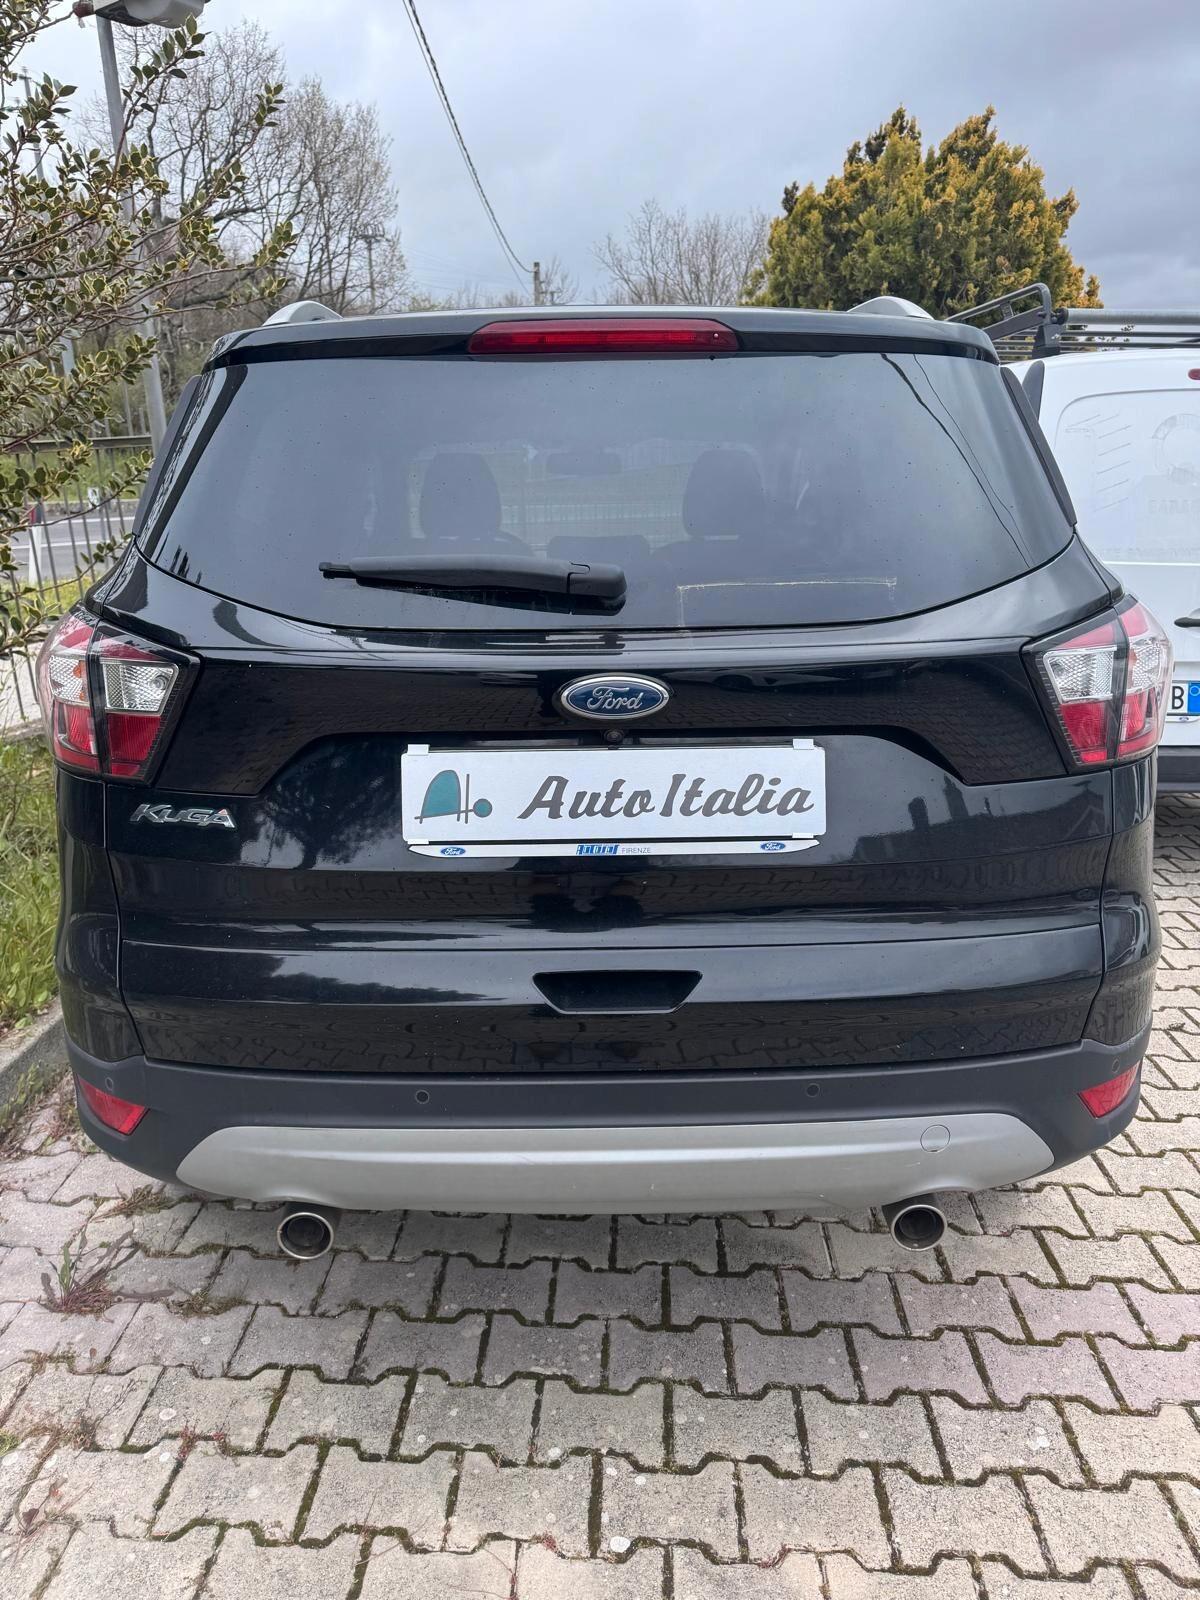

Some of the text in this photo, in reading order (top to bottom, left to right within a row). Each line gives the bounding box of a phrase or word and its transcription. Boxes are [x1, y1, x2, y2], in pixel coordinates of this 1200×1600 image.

[586, 686, 643, 710] Ford
[1171, 685, 1185, 710] B
[129, 803, 235, 828] KUGA
[443, 847, 462, 855] Ford
[763, 842, 781, 850] Ford
